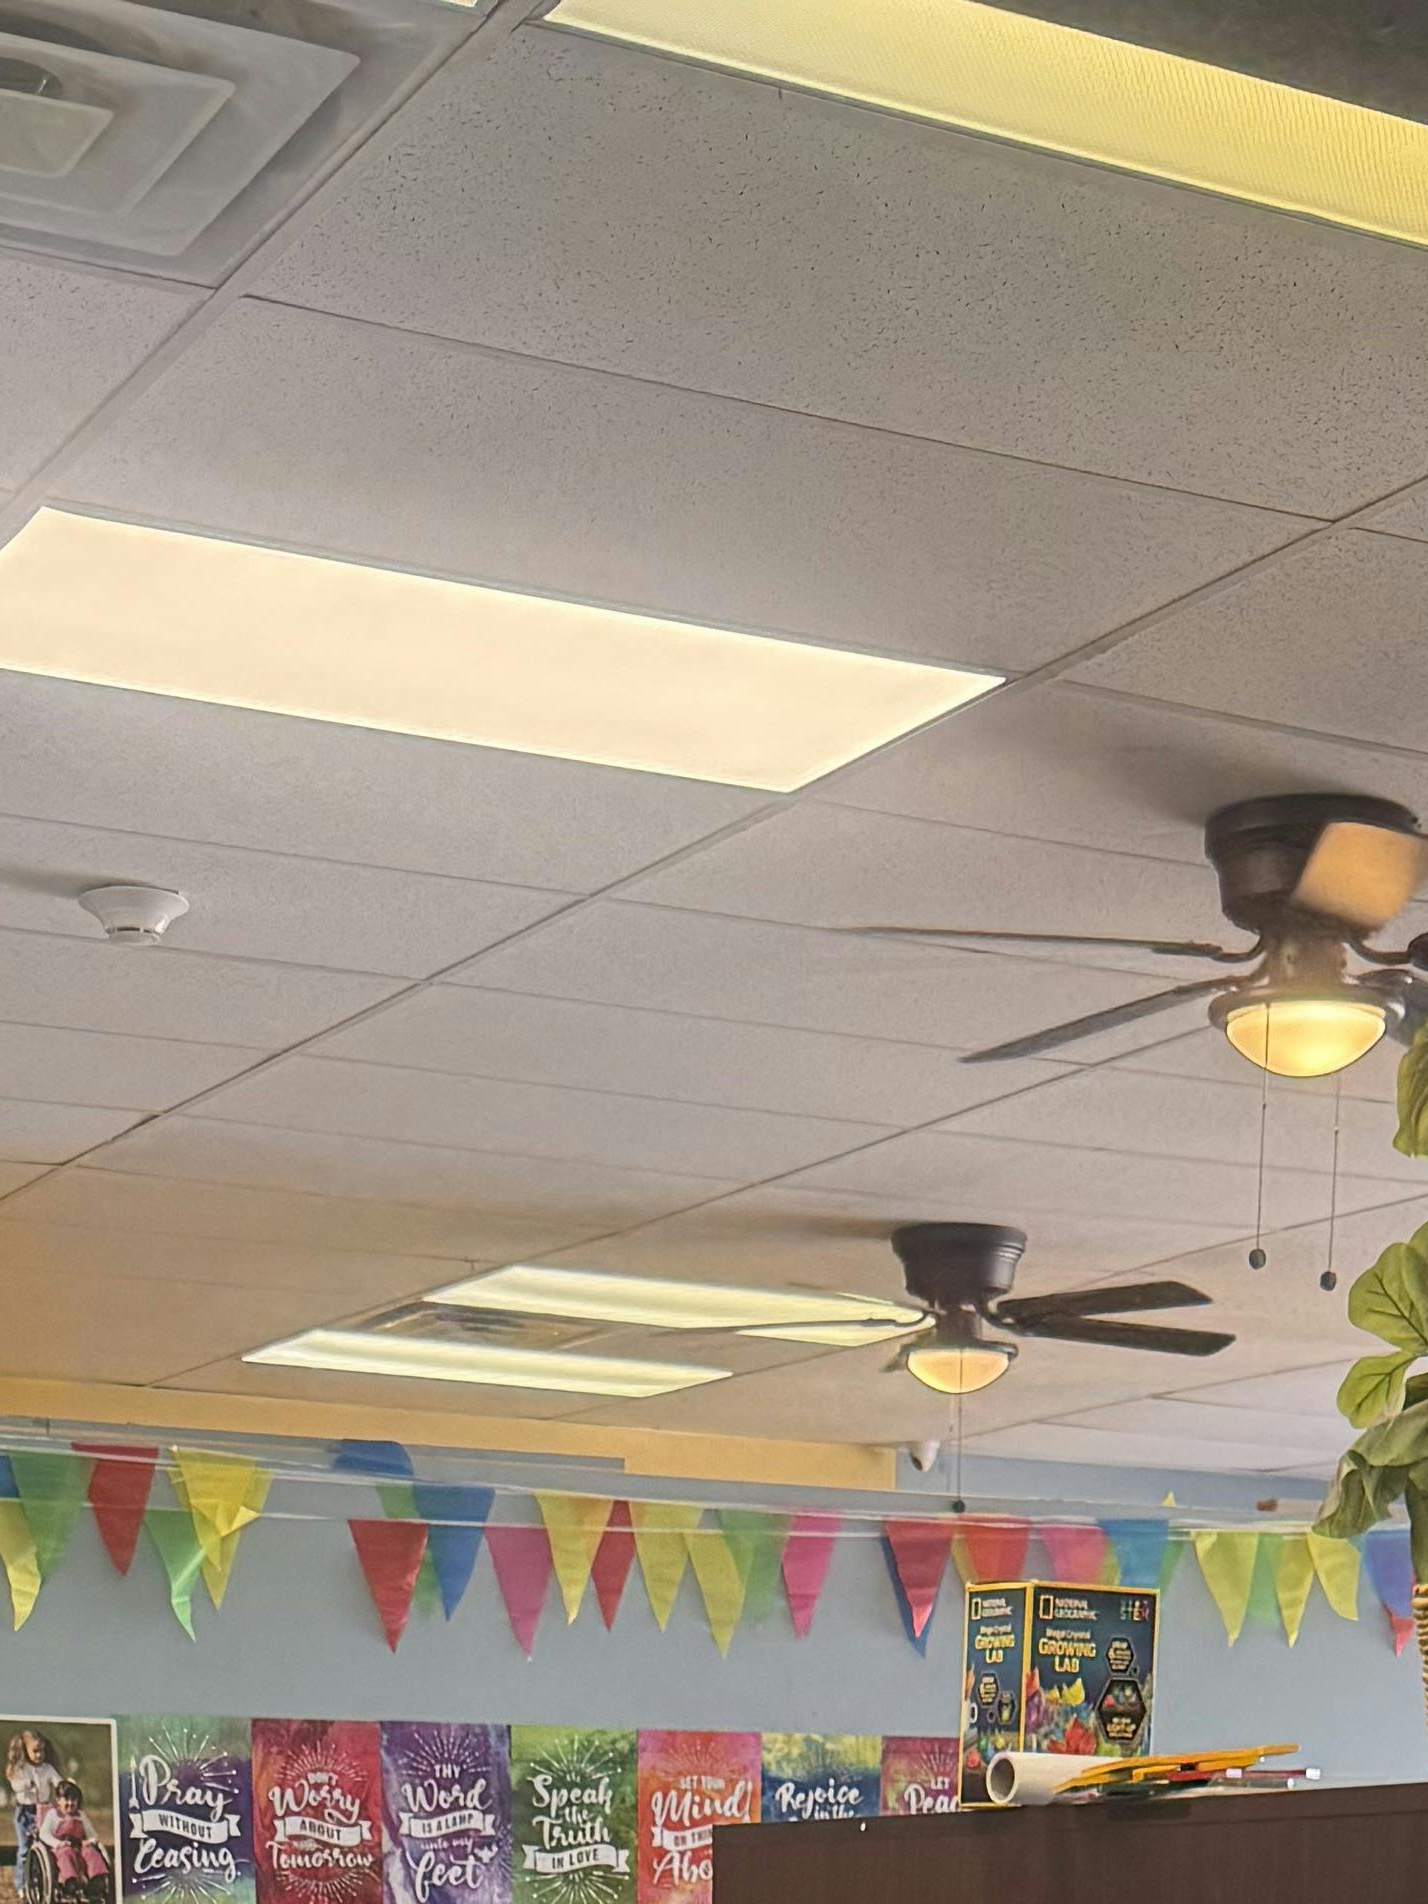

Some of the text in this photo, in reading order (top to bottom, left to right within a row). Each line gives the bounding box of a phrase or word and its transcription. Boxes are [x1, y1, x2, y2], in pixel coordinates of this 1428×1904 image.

[1038, 1637, 1097, 1658] GROWING
[1054, 1656, 1081, 1673] LAB
[434, 1763, 461, 1779] THY
[931, 1775, 950, 1790] LET
[139, 1754, 233, 1822] Pray
[268, 1779, 361, 1825] Worry
[401, 1778, 492, 1813] Word
[527, 1773, 613, 1818] Speak
[775, 1777, 864, 1819] Rejoice
[904, 1783, 958, 1815] Pea
[560, 1805, 593, 1826] the
[651, 1780, 747, 1828] Mind
[814, 1805, 830, 1820] in
[158, 1812, 212, 1840] WITHOUT
[299, 1819, 342, 1841] ABOUT
[422, 1812, 474, 1835] IS A LAMP
[531, 1815, 612, 1850] Truth
[133, 1838, 237, 1883] Ceasing
[265, 1840, 374, 1870] Tomorrow
[552, 1848, 600, 1870] IN LOVE
[653, 1851, 712, 1886] Abo
[414, 1850, 483, 1904] feet
